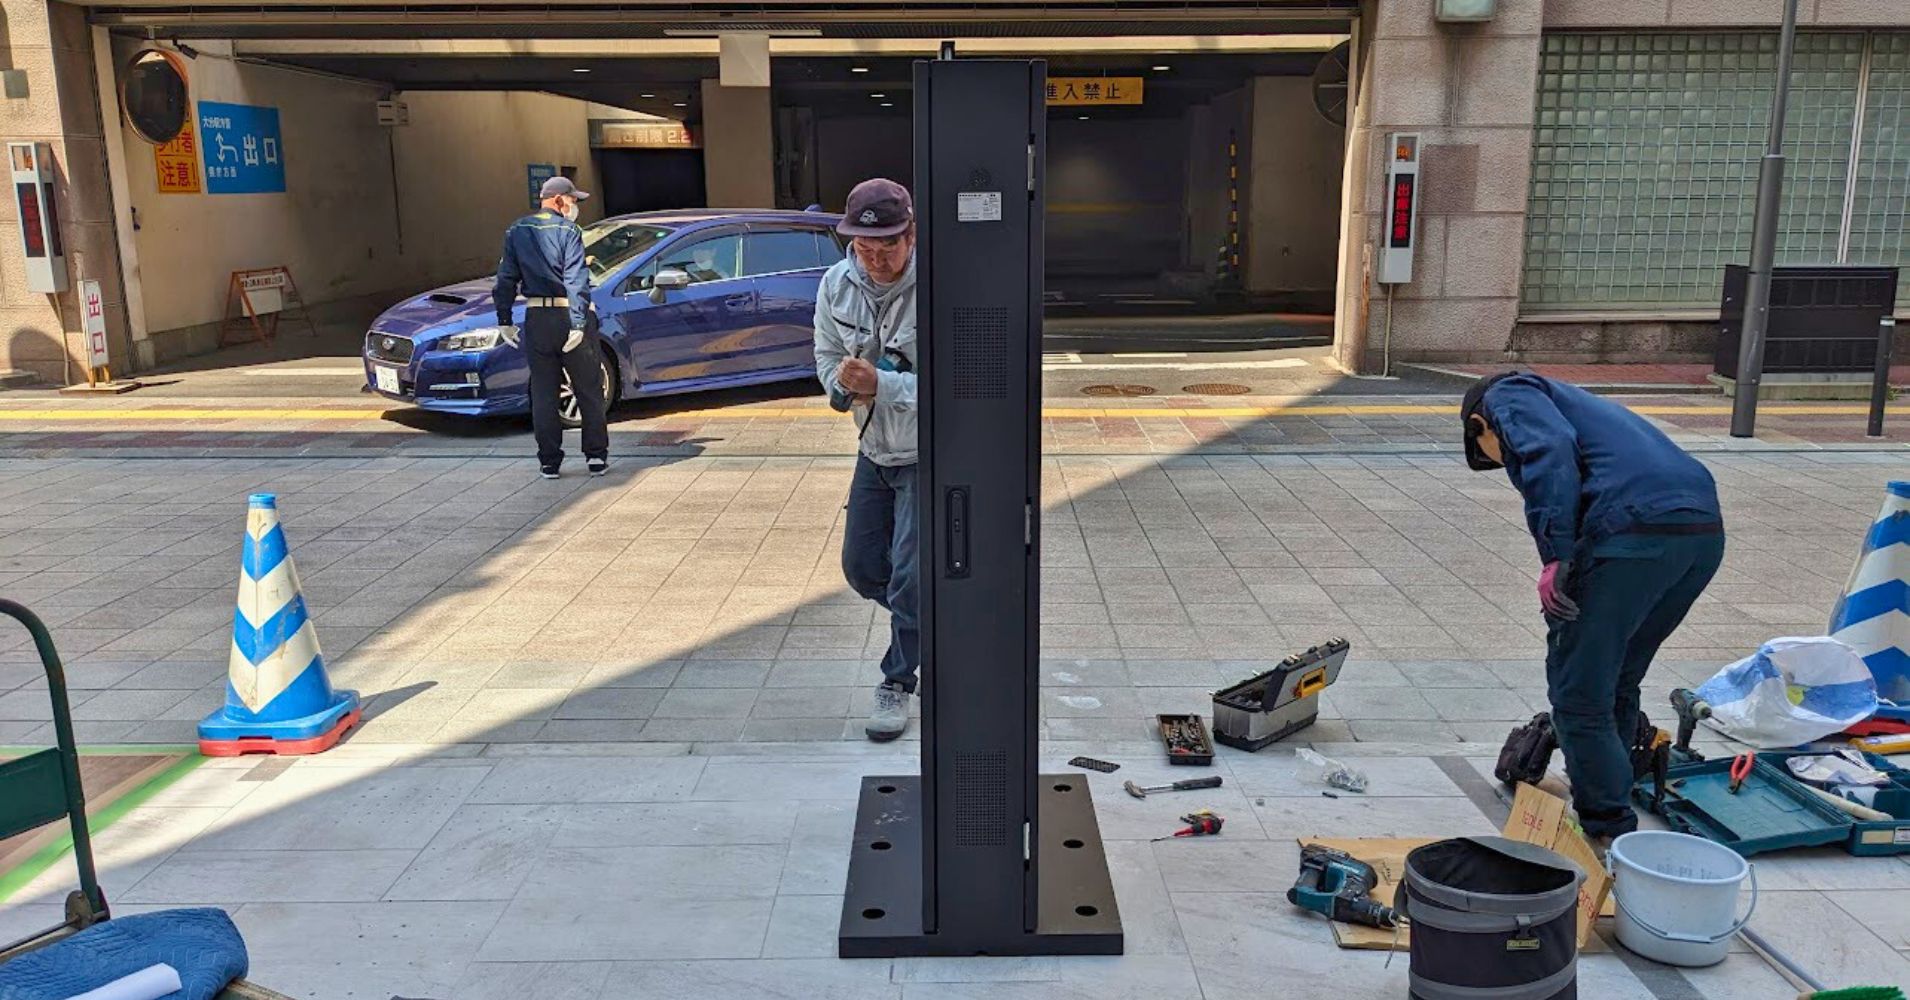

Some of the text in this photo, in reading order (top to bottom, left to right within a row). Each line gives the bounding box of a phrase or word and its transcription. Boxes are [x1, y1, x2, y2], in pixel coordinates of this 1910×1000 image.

[1047, 83, 1121, 101] 進入禁止
[242, 133, 278, 166] 出口
[88, 293, 105, 354] 出口
